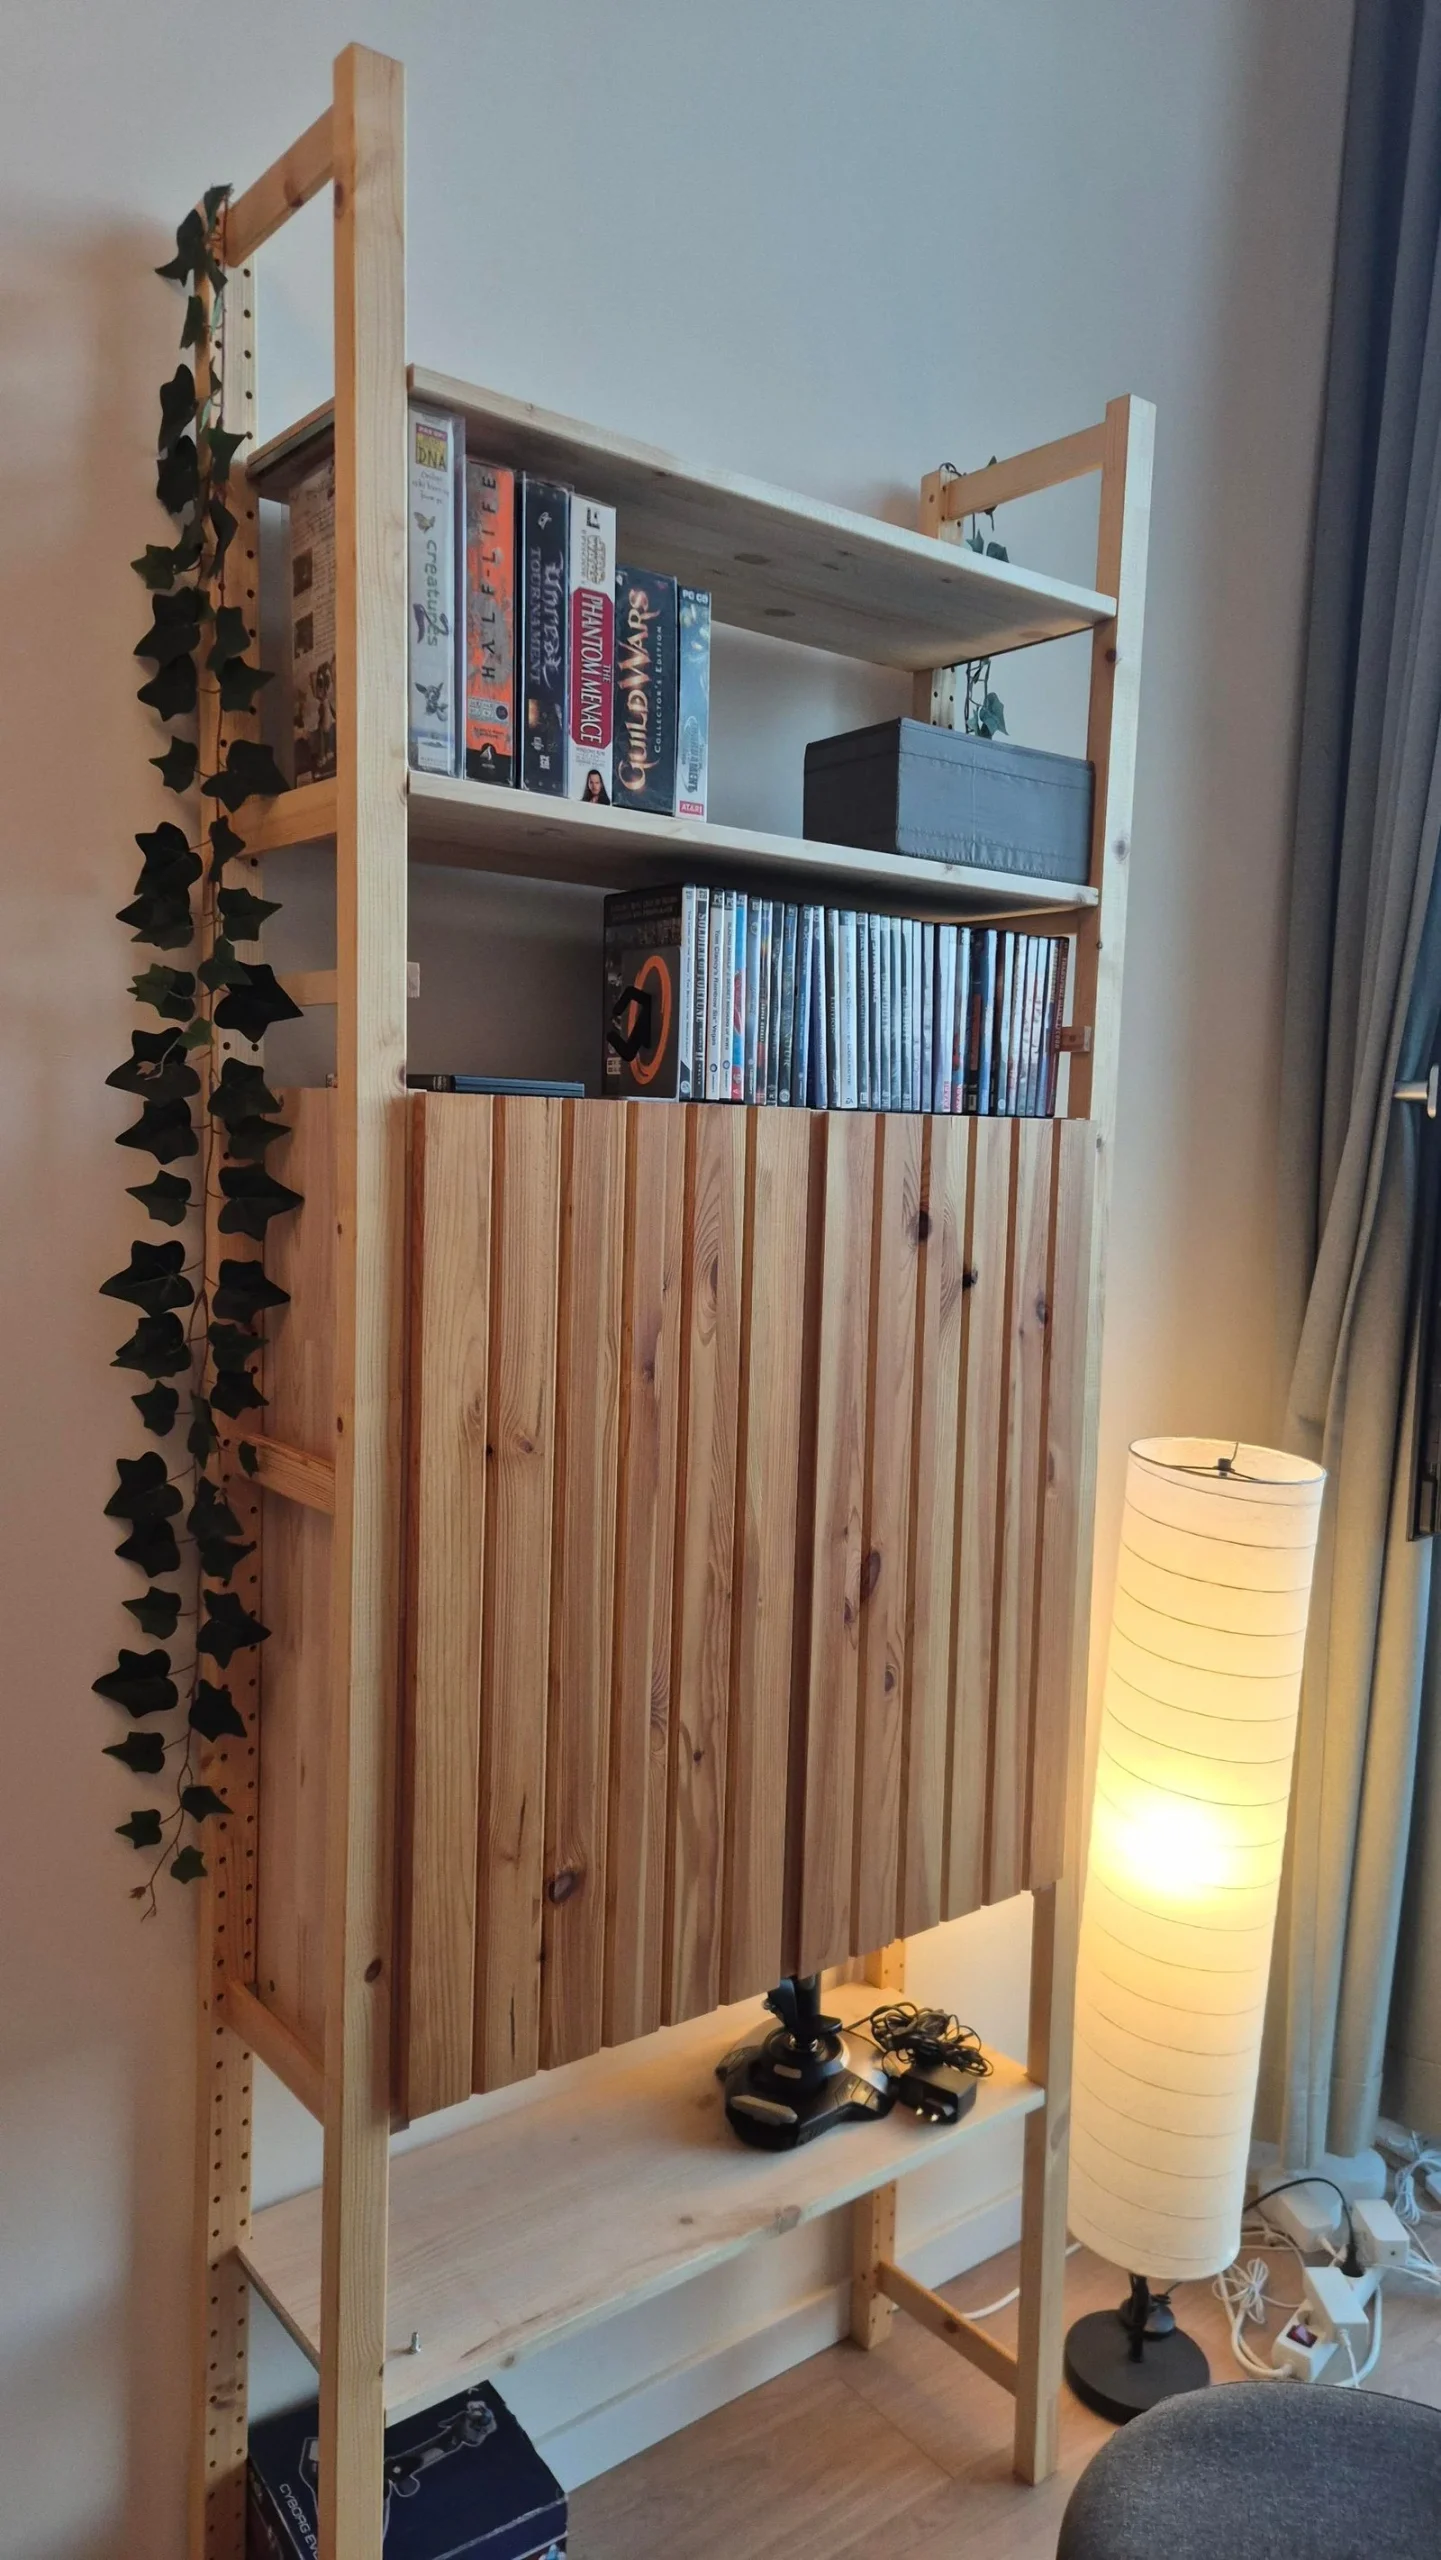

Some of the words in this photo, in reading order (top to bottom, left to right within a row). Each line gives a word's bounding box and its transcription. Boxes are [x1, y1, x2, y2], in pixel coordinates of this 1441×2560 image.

[529, 546, 543, 686] TOURNAMENT
[580, 592, 603, 676] PHANTOM
[603, 664, 611, 684] THE
[579, 677, 603, 744] MENACE
[681, 803, 703, 814] ATARI
[697, 913, 707, 960] SOLDIER
[696, 973, 706, 1023] FORTUNE
[710, 1025, 718, 1046] Vegas
[279, 2483, 311, 2534] CYBORG
